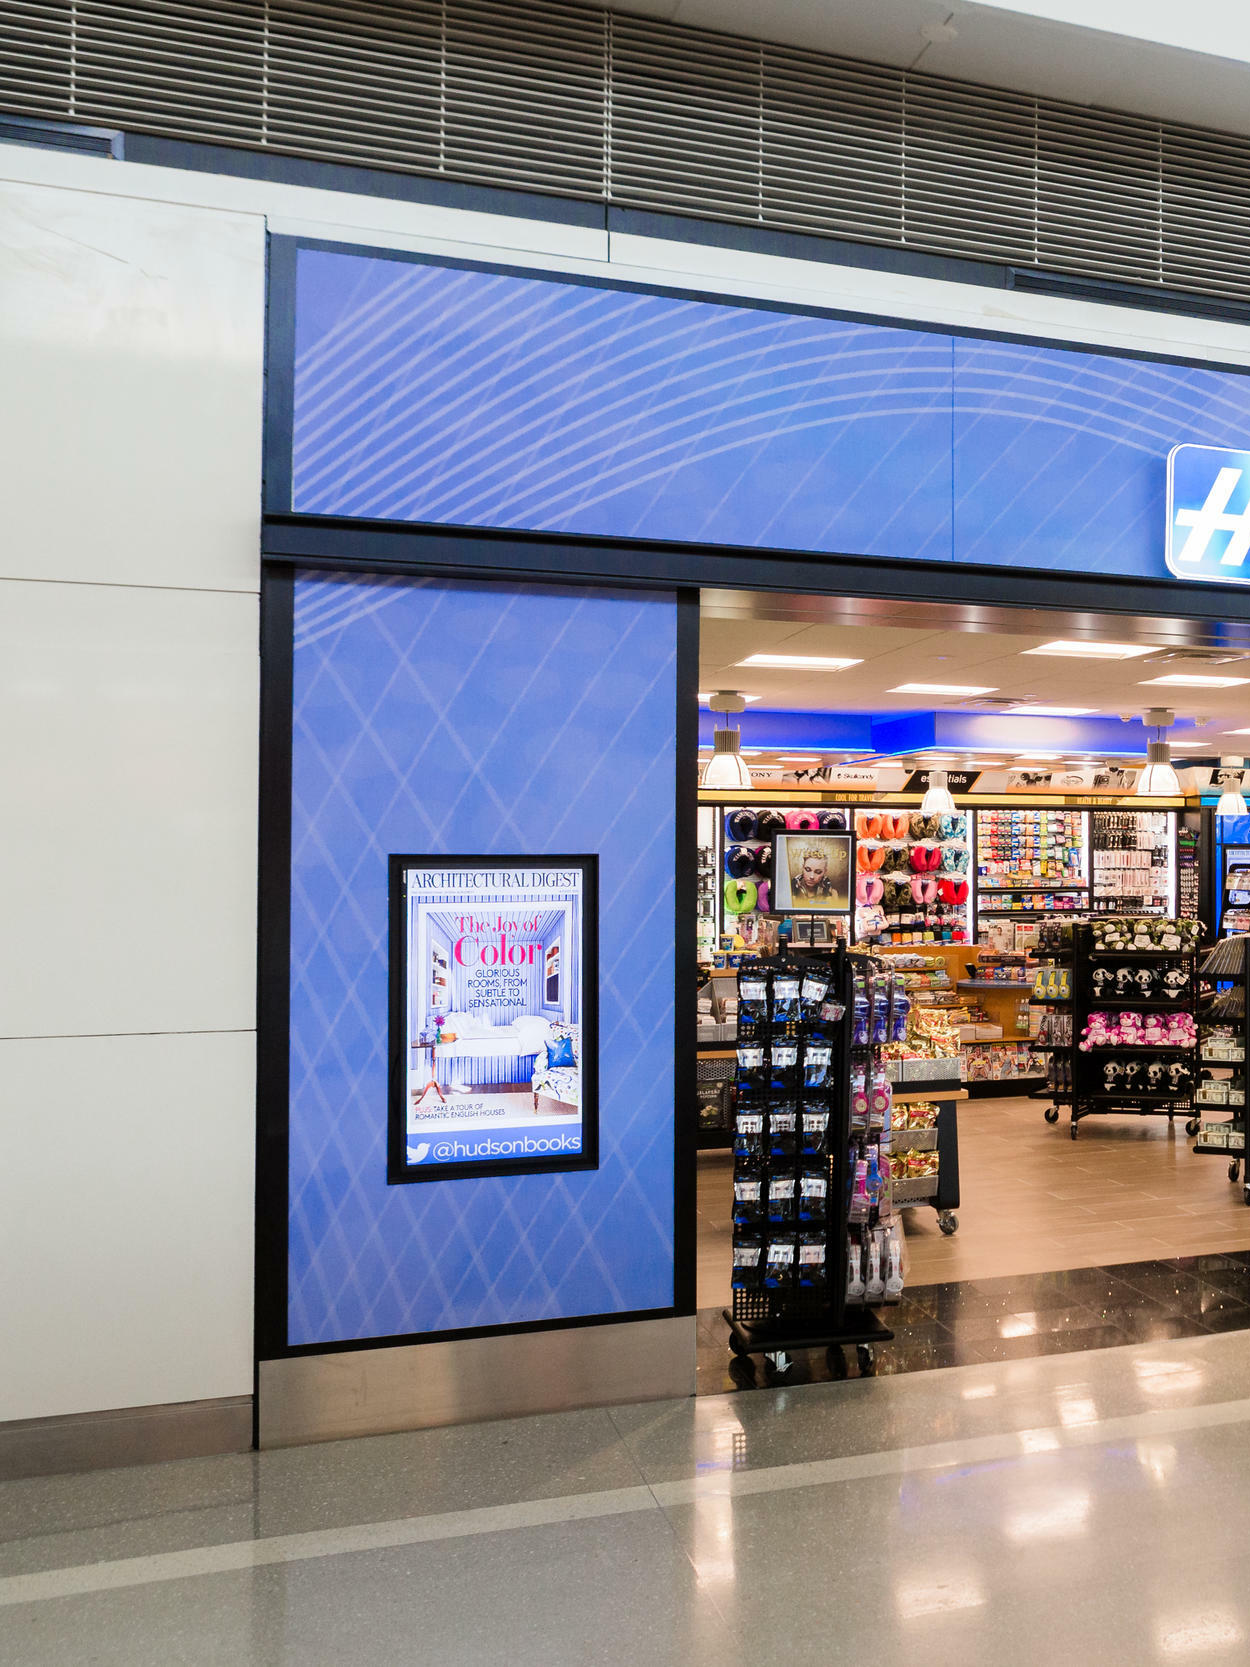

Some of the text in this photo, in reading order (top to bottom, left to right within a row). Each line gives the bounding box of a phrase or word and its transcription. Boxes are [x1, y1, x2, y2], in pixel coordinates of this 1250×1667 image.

[921, 774, 967, 784] estials
[412, 872, 580, 888] ARCHITECTURAL DIGEST
[455, 914, 542, 939] The Joy of
[454, 934, 543, 967] Color
[475, 968, 520, 978] GLORIOUS
[467, 978, 528, 989] ROOMS, FROM
[475, 987, 520, 998] SUBTLE TO
[468, 998, 527, 1008] SENSATIONAL
[415, 1112, 450, 1120] ROMANTIC
[480, 1109, 506, 1117] HOUSES
[432, 1133, 582, 1162] @hudsonbooks
